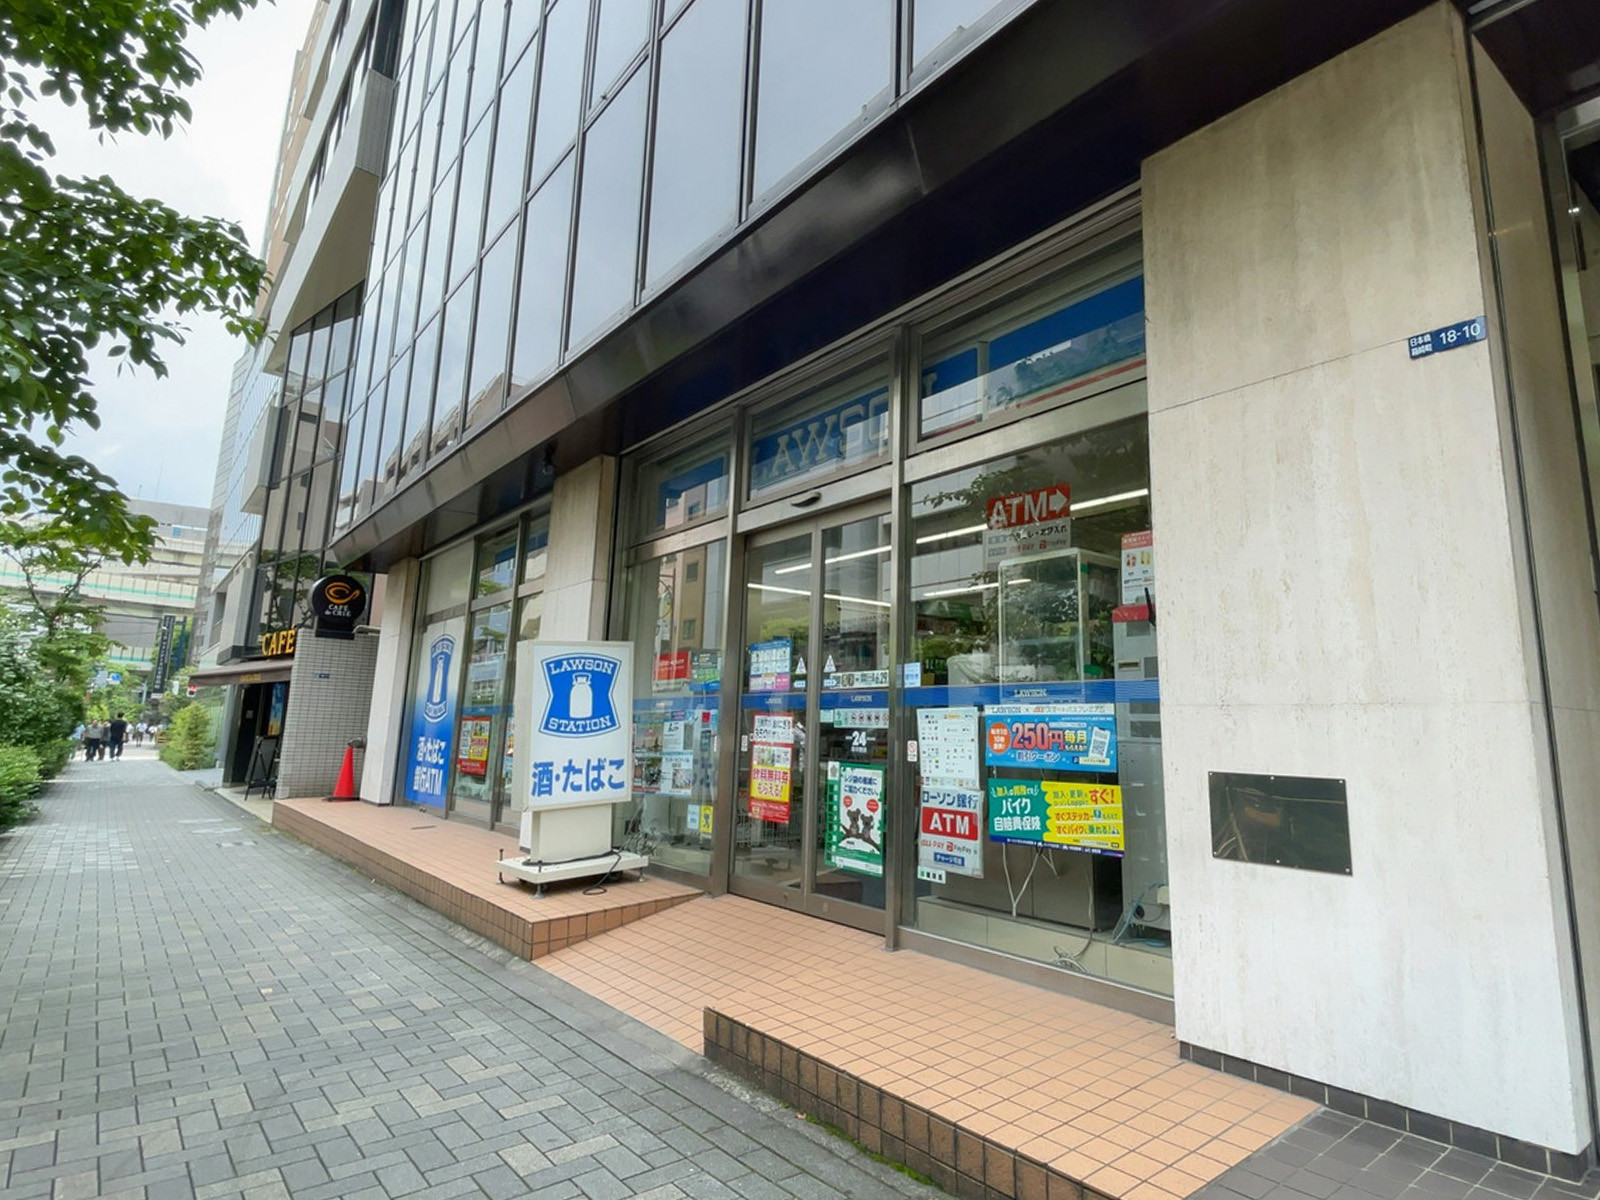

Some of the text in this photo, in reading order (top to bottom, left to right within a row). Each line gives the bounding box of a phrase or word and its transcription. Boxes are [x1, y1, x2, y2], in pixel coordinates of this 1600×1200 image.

[1439, 323, 1480, 345] 18-10
[989, 491, 1047, 526] ATM
[549, 659, 613, 675] LAWSON
[548, 715, 612, 732] STATION
[852, 730, 867, 747] 24
[1012, 722, 1064, 751] 250円
[1016, 750, 1061, 763] 割引クーポン
[531, 757, 625, 797] 酒・たばこ
[922, 791, 979, 810] ローソン銀行
[1002, 798, 1031, 815] バイク
[929, 812, 970, 836] ATM
[994, 816, 1042, 831] 自賠責保険
